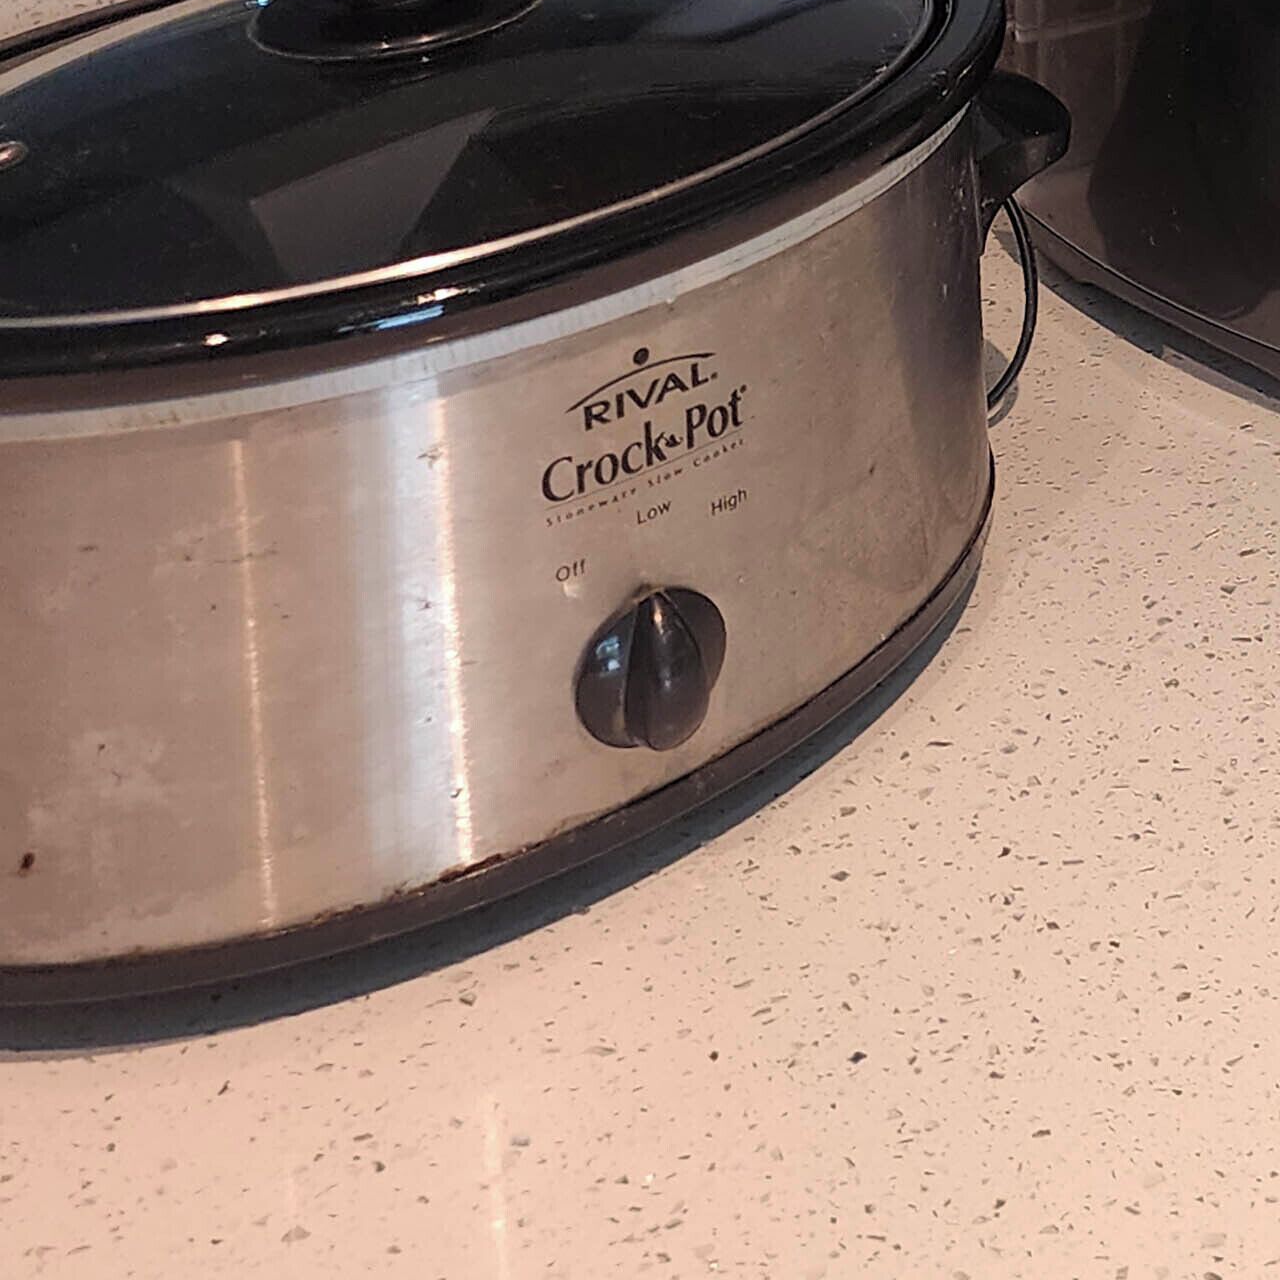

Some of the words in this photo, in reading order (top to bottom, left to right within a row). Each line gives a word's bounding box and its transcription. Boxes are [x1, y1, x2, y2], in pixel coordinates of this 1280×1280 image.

[583, 362, 710, 432] RIVAL
[636, 500, 672, 525] Low
[710, 487, 749, 517] High
[554, 557, 587, 583] Off
